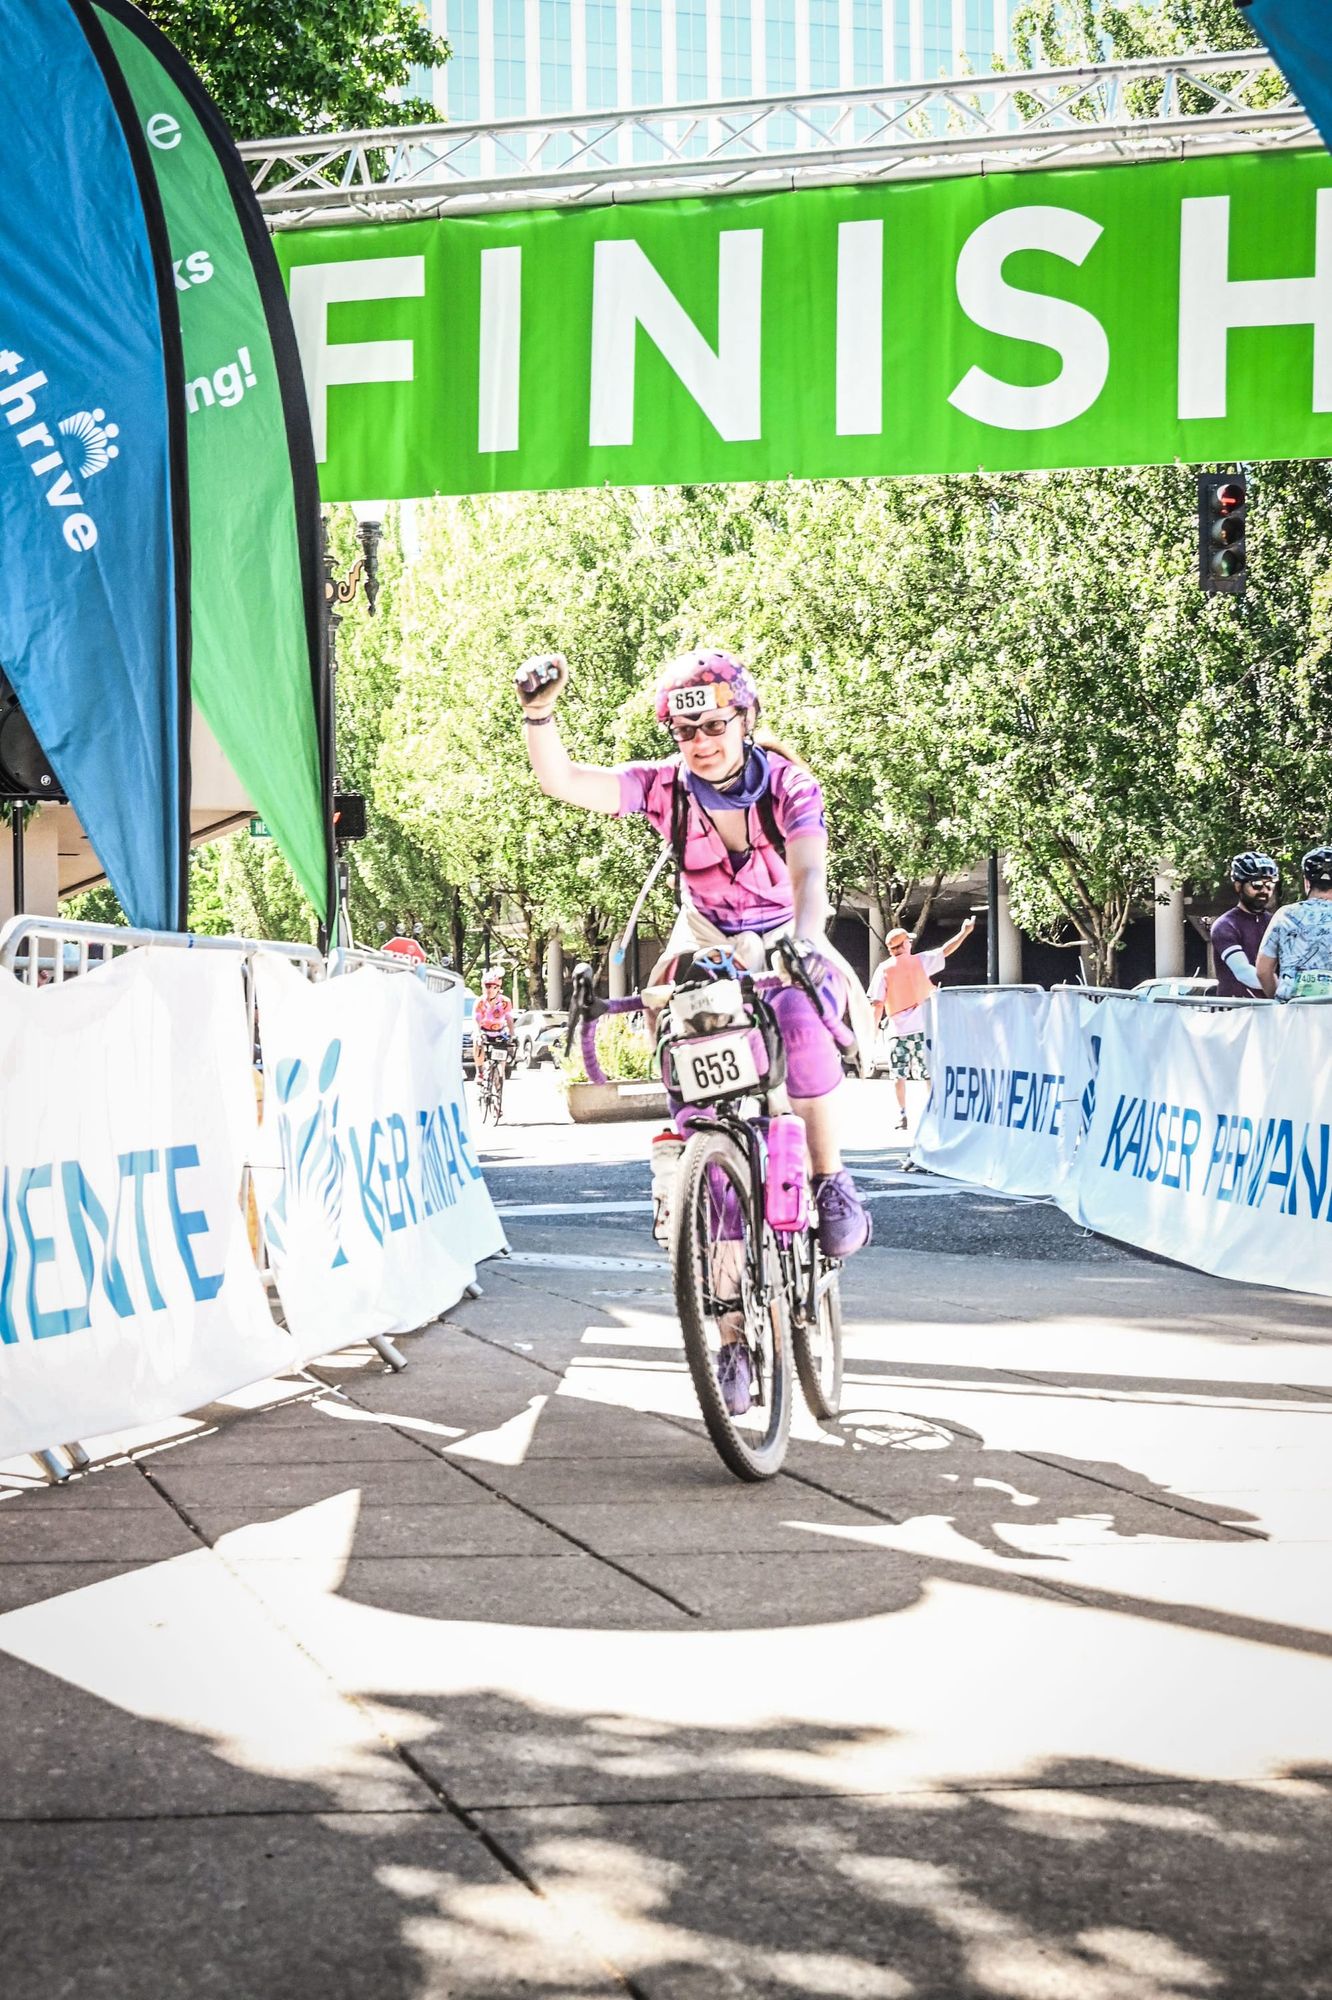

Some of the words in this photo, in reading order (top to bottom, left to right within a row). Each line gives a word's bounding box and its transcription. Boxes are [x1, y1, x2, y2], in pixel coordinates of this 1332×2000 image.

[289, 188, 1332, 464] FINISH
[0, 349, 98, 552] thrive
[675, 690, 706, 710] 653
[692, 1049, 741, 1089] 653
[1100, 1094, 1201, 1193] KAISER
[1202, 1113, 1332, 1223] PERMAN
